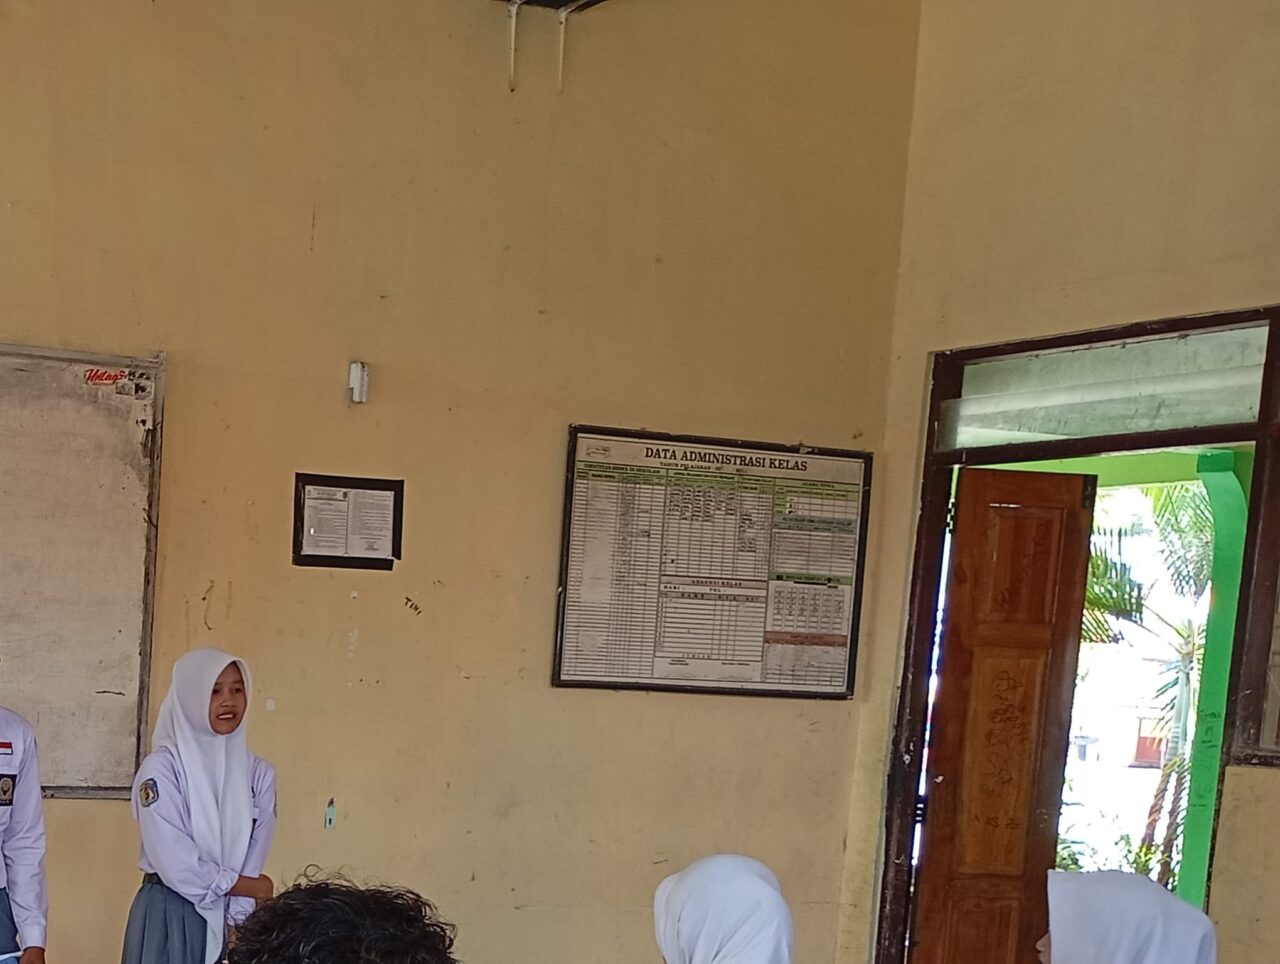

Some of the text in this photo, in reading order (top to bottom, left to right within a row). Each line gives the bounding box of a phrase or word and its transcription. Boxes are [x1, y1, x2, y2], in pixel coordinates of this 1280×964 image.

[645, 447, 808, 471] DATA ADMINISTRASI KELAS
